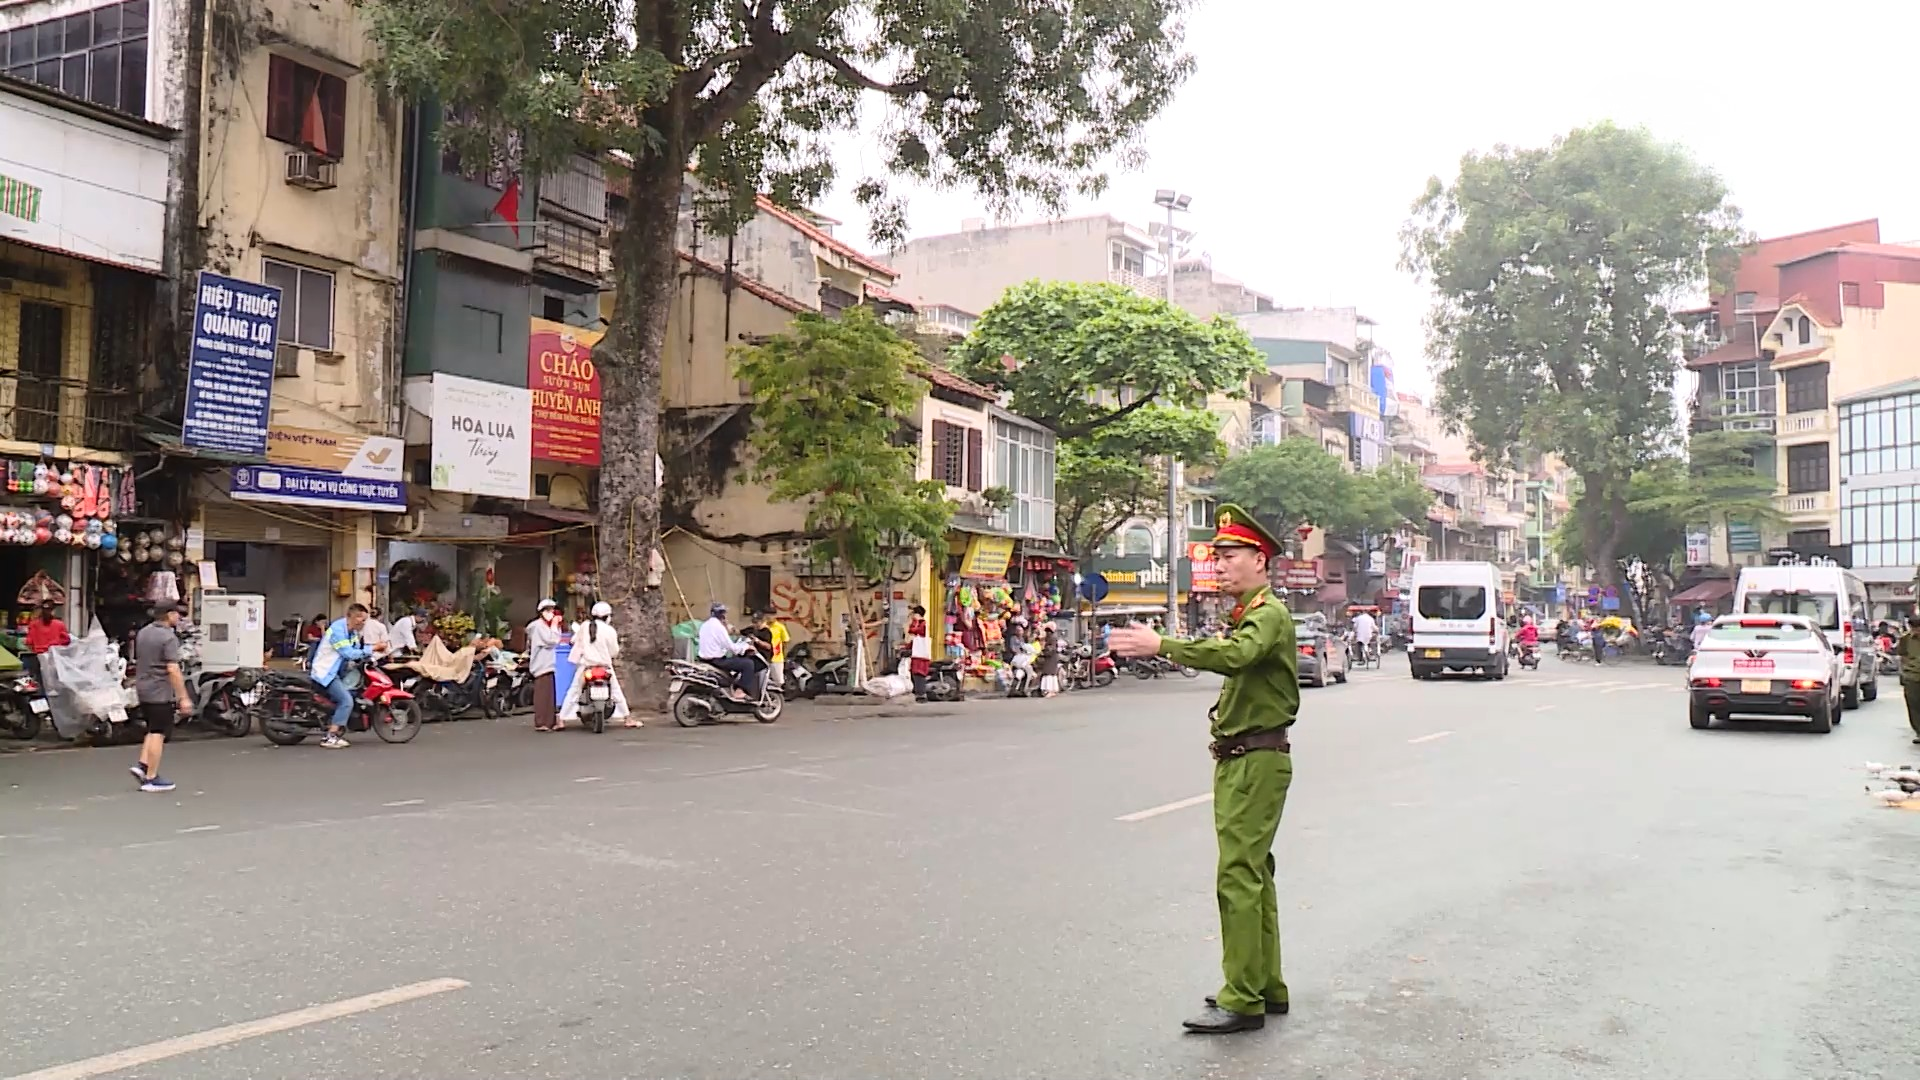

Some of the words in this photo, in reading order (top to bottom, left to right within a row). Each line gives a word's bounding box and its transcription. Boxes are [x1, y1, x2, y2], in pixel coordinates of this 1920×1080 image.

[202, 284, 233, 310] HIỆU
[236, 293, 277, 318] THUỐC
[203, 311, 249, 339] QUẢNG
[251, 322, 272, 345] LỢI
[540, 351, 594, 381] CHÁO
[575, 397, 602, 416] ANH
[452, 415, 485, 435] HOA
[488, 421, 515, 442] LỤA
[315, 439, 337, 447] NAM
[299, 476, 309, 490] LÝ
[310, 479, 327, 493] DỊCH
